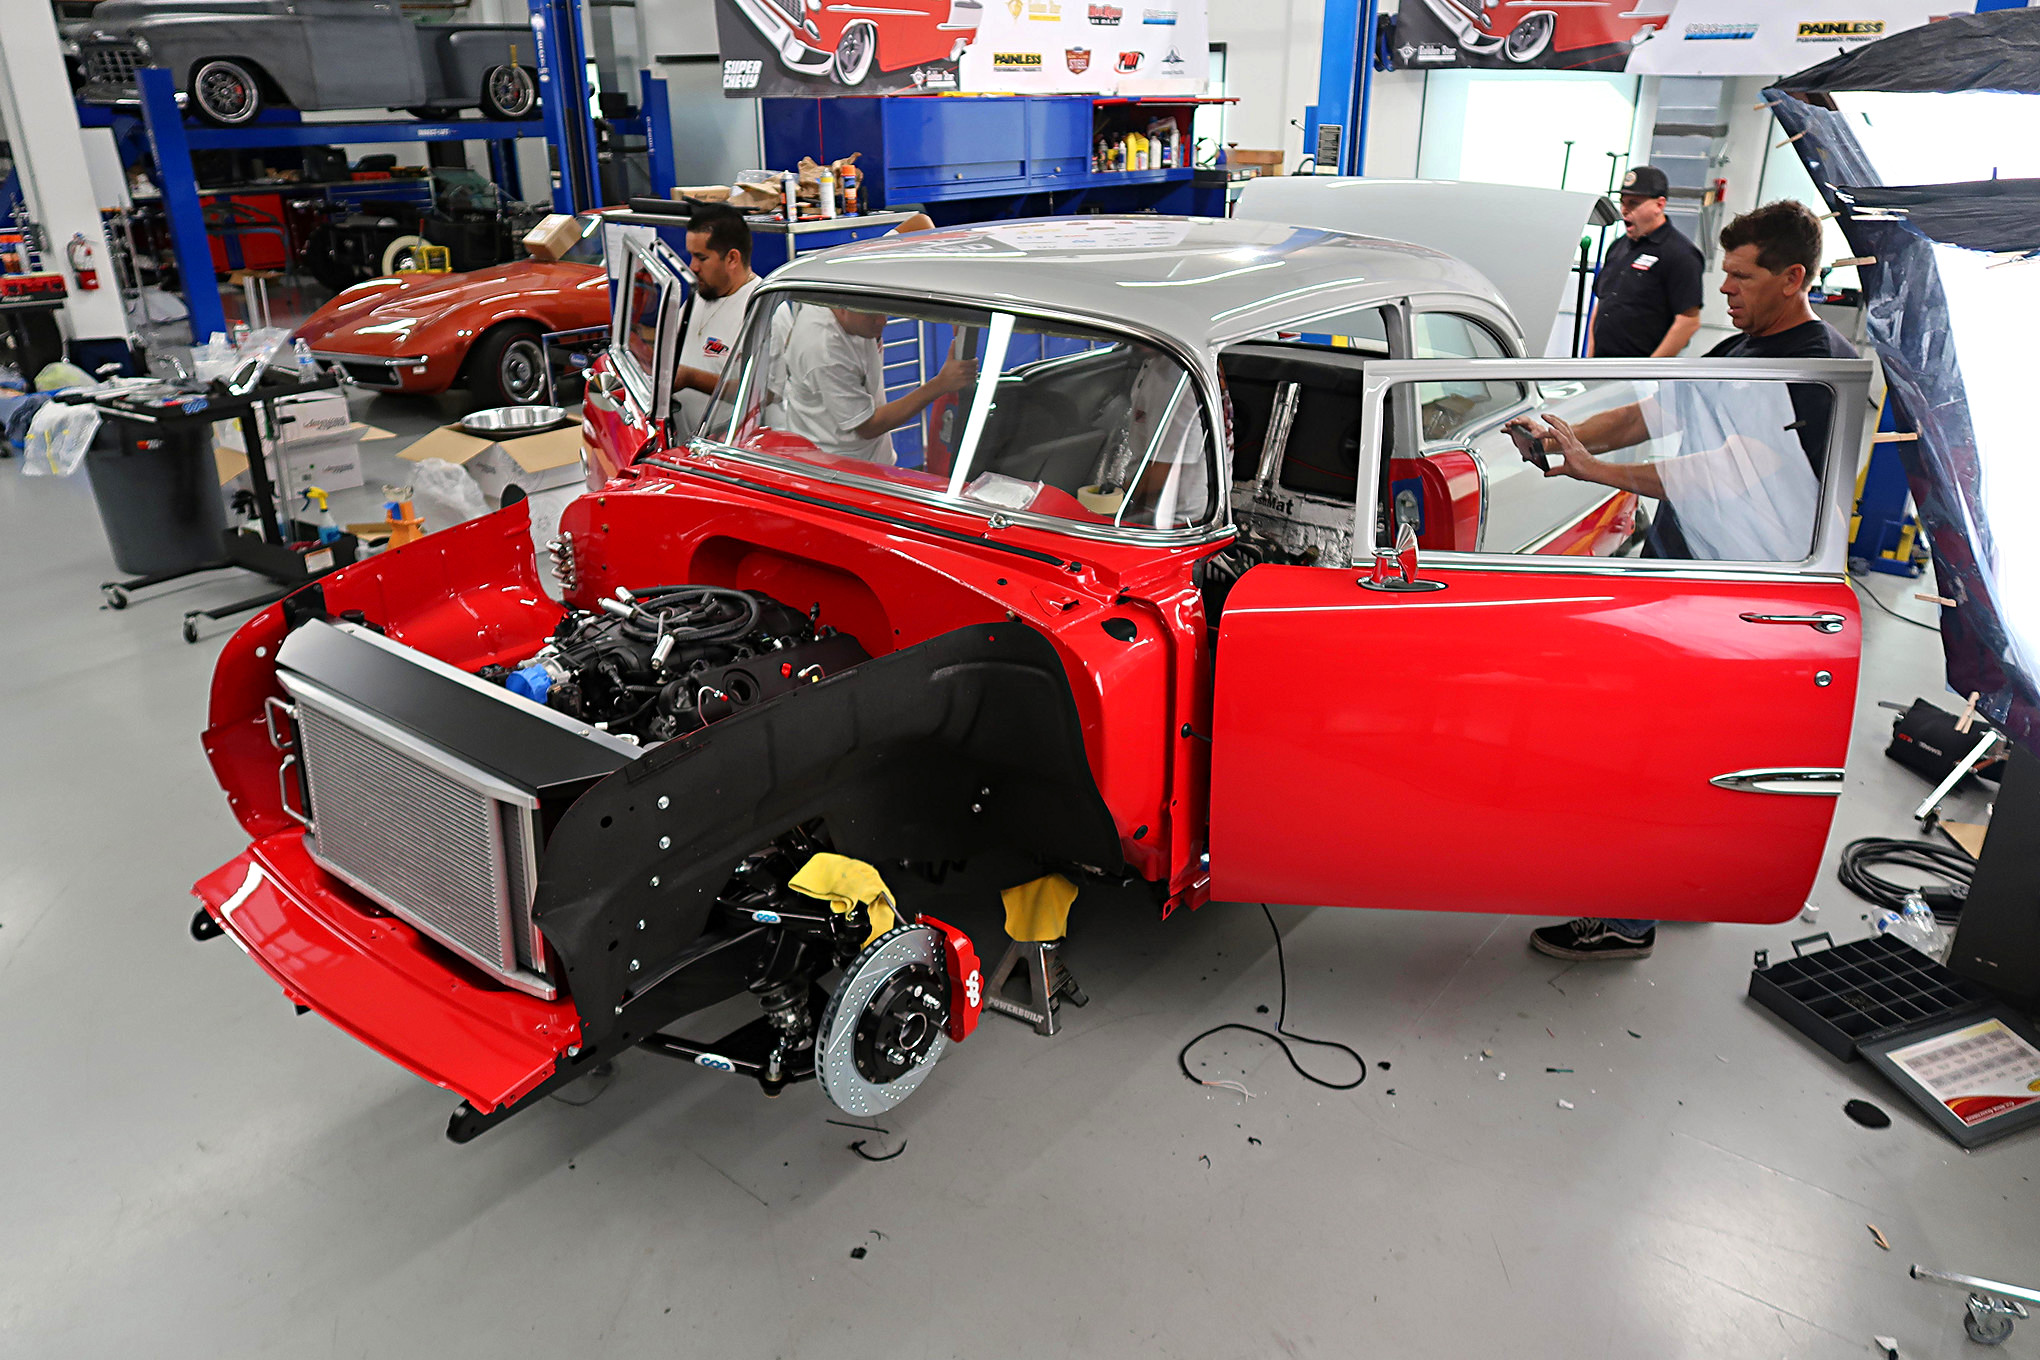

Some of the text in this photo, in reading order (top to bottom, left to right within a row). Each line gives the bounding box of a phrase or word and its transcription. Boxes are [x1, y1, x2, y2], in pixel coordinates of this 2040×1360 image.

[1799, 22, 1884, 34] PAINLESS
[993, 54, 1041, 65] PAINLESS
[723, 60, 763, 74] SUPER
[722, 73, 760, 89] CHEVY
[988, 996, 1044, 1023] POWERBUILT
